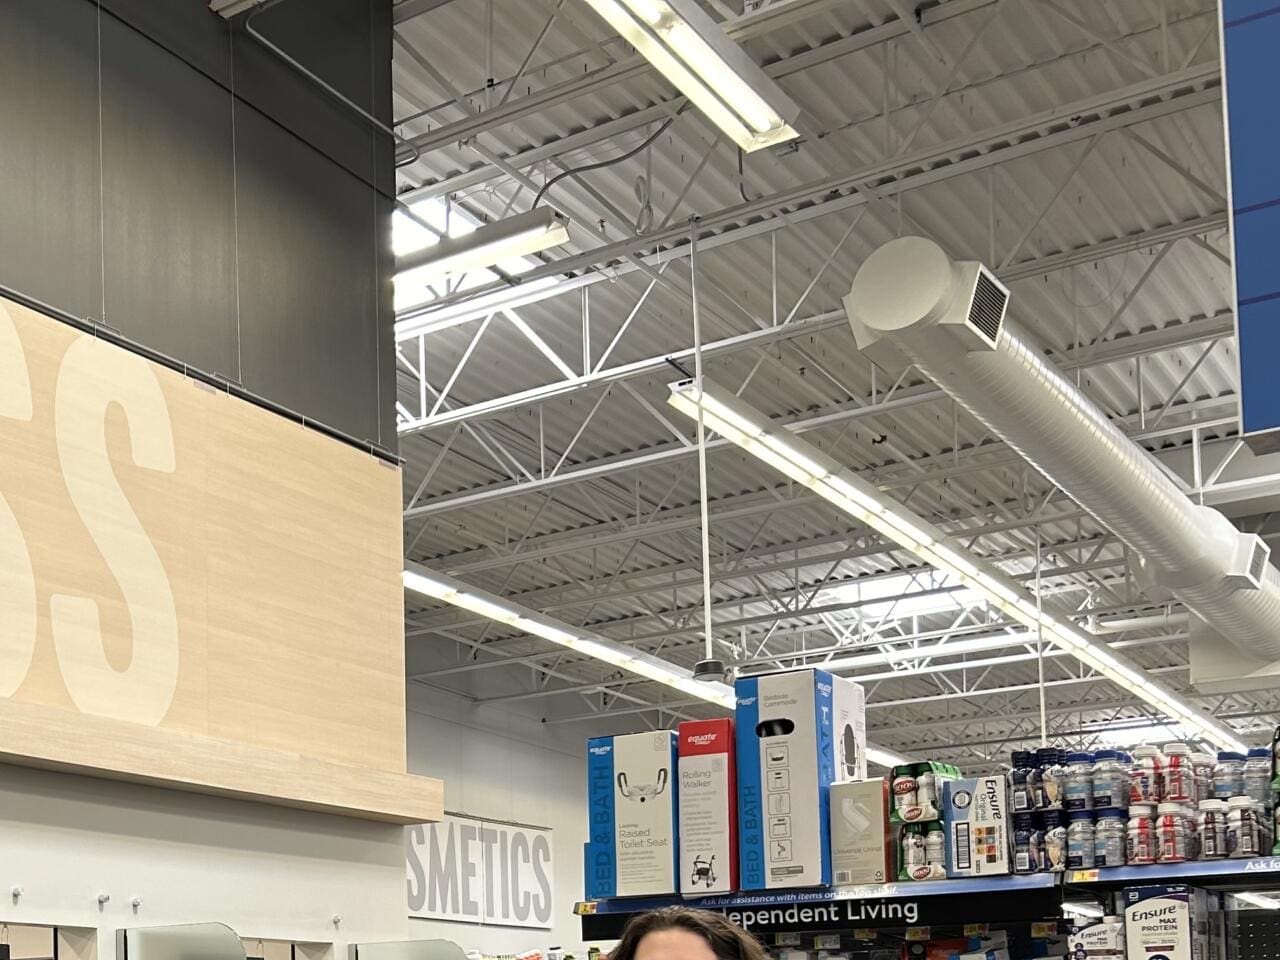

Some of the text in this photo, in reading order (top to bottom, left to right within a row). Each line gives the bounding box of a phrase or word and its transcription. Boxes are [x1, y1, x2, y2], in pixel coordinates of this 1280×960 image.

[688, 734, 717, 742] equate
[683, 770, 711, 779] Rolling
[683, 780, 712, 788] Walker
[985, 779, 1002, 819] Ensure
[594, 765, 611, 895] BED & BATH
[619, 828, 650, 838] Raised
[744, 785, 760, 885] BED & BATH
[620, 838, 669, 849] Toilet Seat
[1245, 861, 1268, 870] Ask
[406, 821, 552, 924] SMETICS
[731, 895, 775, 904] assistance
[776, 893, 796, 902] with
[798, 892, 823, 900] items
[847, 899, 918, 923] Living
[1131, 904, 1177, 922] Ensure
[1159, 917, 1177, 925] MAX
[1141, 924, 1178, 932] PROTEIN
[1081, 928, 1108, 940] Ensure
